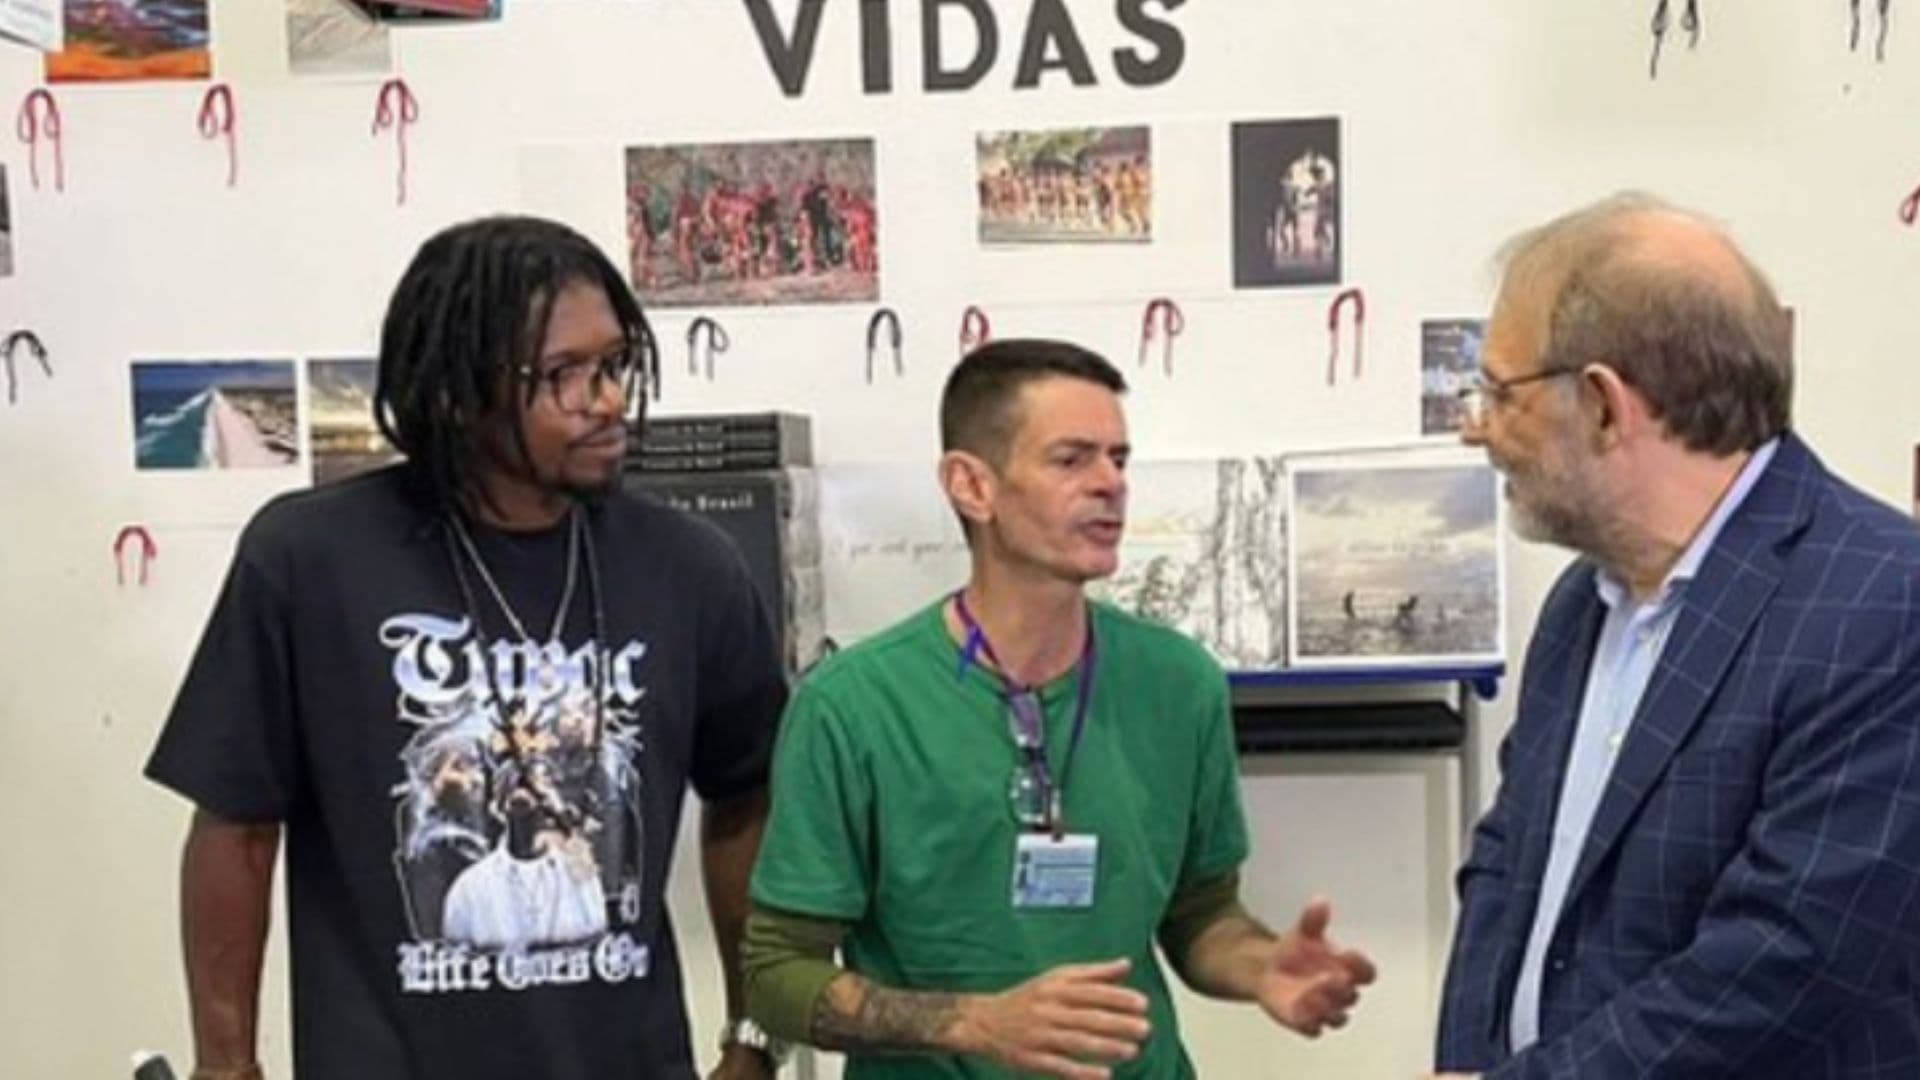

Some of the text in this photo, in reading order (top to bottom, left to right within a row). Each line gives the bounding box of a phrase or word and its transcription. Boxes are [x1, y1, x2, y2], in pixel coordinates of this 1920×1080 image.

[743, 0, 1187, 98] VIDAS
[379, 612, 646, 703] Tupac
[397, 940, 490, 993] Life
[496, 948, 590, 991] Goes
